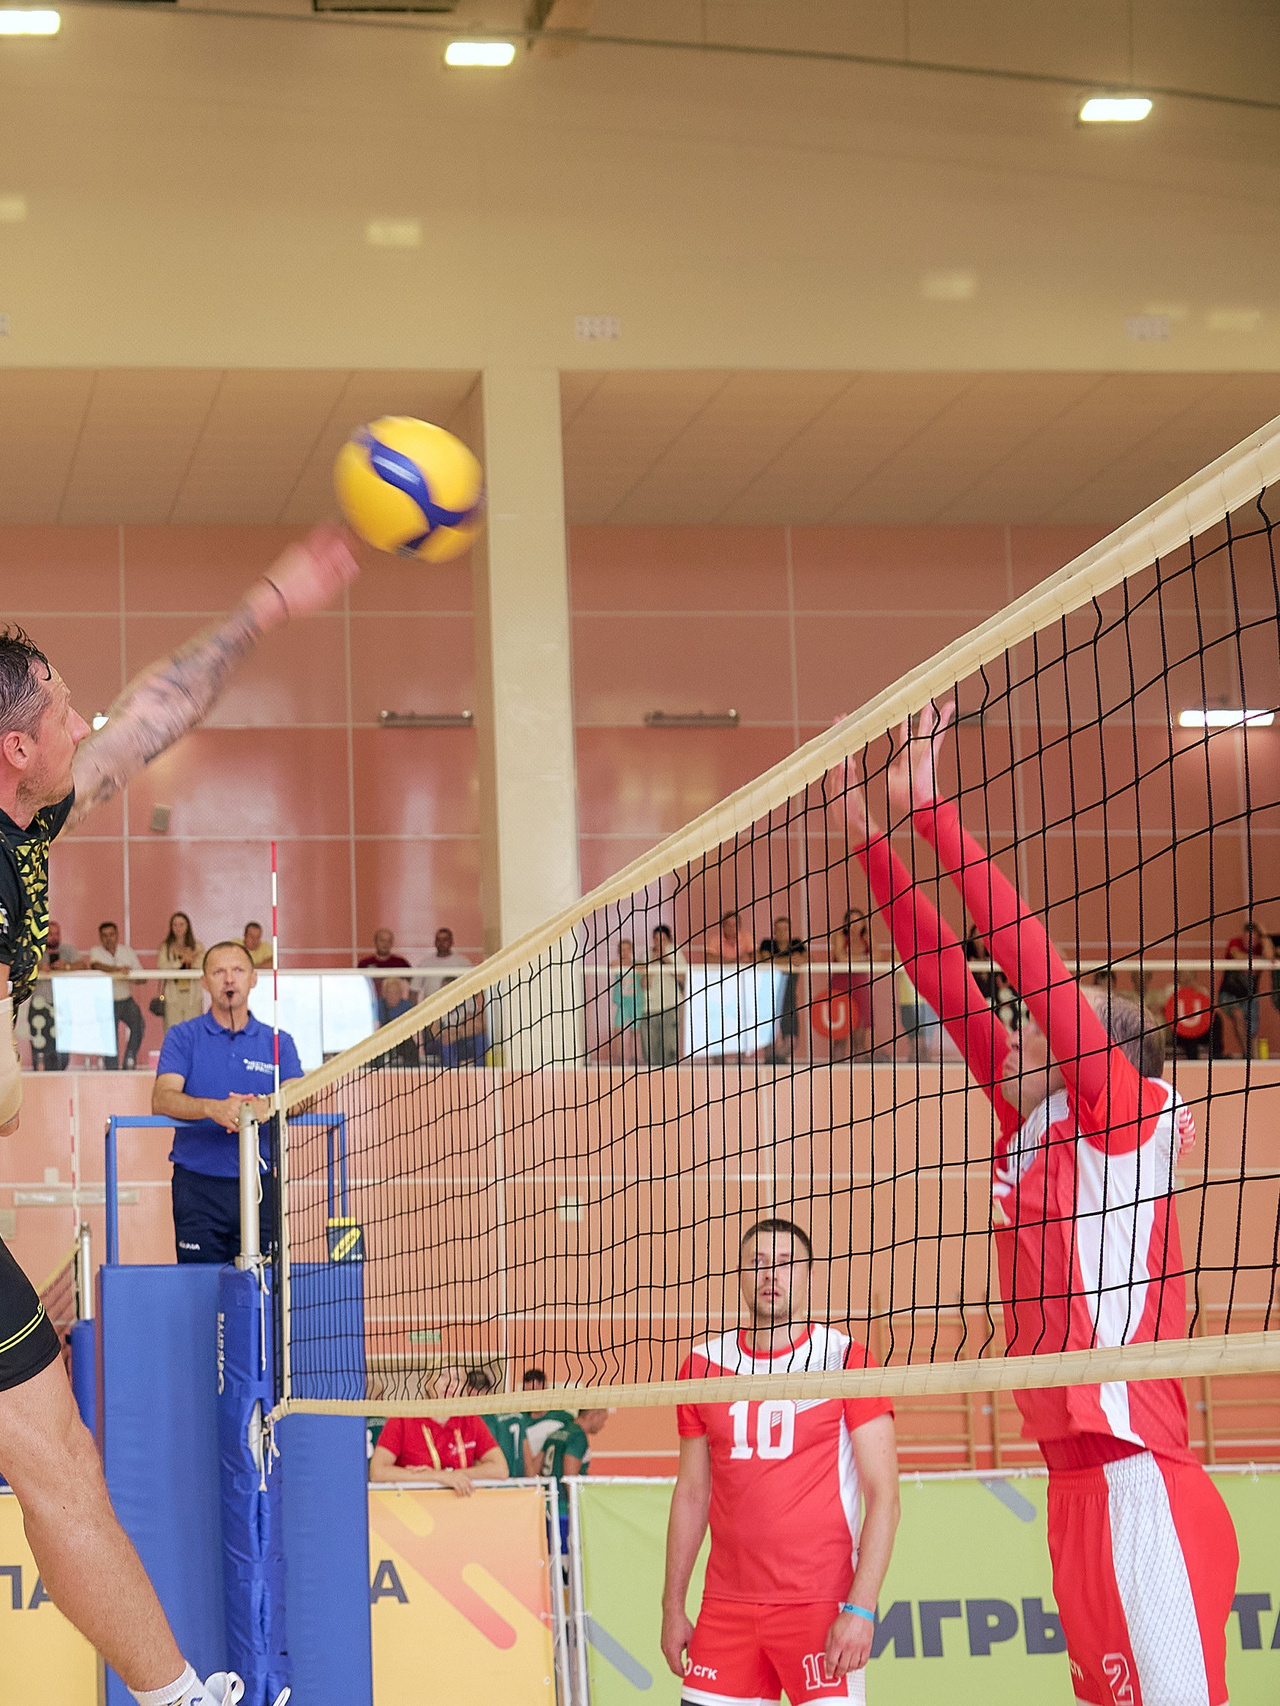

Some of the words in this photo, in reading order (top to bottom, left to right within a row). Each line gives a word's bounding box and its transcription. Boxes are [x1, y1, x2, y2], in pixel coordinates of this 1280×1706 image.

[821, 1001, 846, 1030] U
[728, 1399, 796, 1460] 10
[693, 1664, 718, 1681] СГК
[1102, 1652, 1134, 1706] 2
